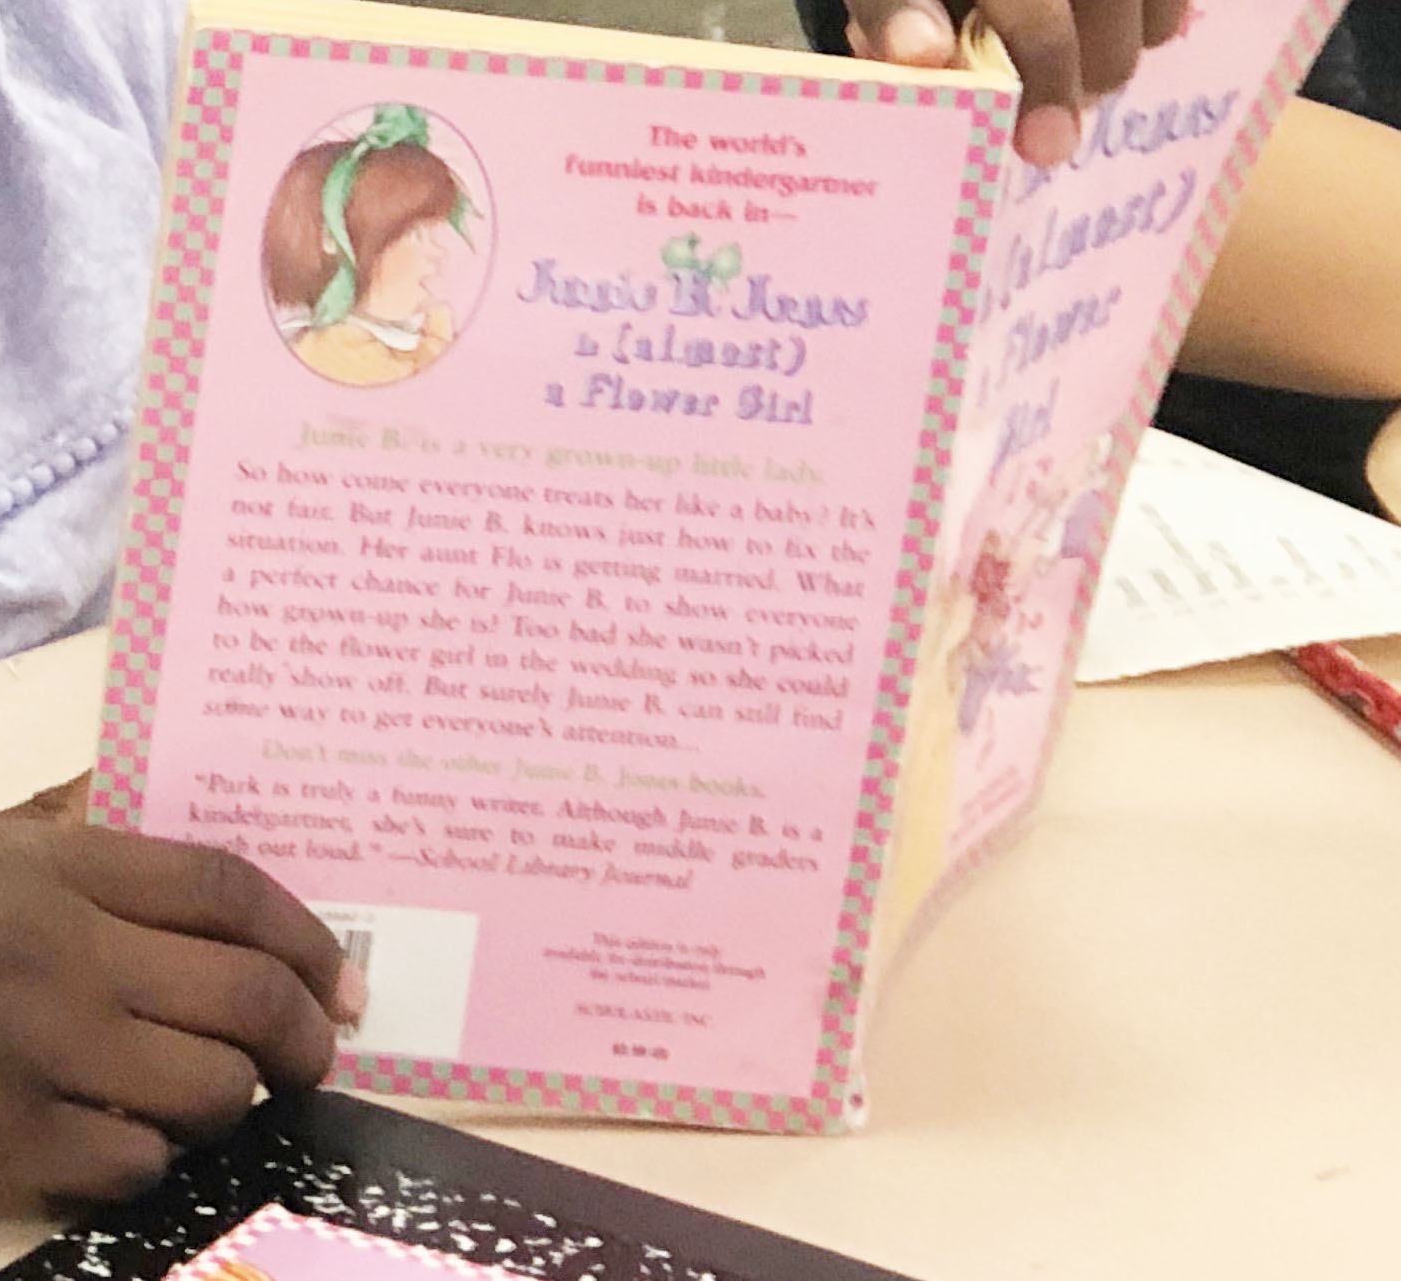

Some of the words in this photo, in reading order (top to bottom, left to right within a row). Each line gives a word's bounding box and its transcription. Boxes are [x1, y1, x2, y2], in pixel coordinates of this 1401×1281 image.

[649, 124, 697, 150] The
[709, 134, 806, 158] world's
[564, 153, 679, 184] funniest
[689, 164, 879, 197] kindergartner
[636, 193, 655, 215] is
[668, 195, 732, 220] back
[515, 258, 658, 313] Junie
[732, 274, 868, 329] Jones
[612, 320, 806, 377] (almost)
[545, 383, 565, 408] a
[579, 372, 719, 416] Flower
[737, 384, 813, 425] Girl
[297, 421, 369, 450] Junie
[478, 440, 532, 462] very
[546, 447, 681, 477] grown-up
[692, 452, 749, 479] little
[237, 461, 267, 482] So
[276, 461, 329, 486] how
[342, 475, 410, 494] come
[419, 477, 535, 504] everyone
[544, 487, 614, 509] treats
[624, 489, 664, 513] her
[675, 492, 721, 518] like
[730, 503, 743, 520] a
[840, 504, 876, 531] It's
[231, 499, 274, 518] not
[349, 501, 393, 526] But
[406, 504, 472, 531] Junie
[523, 514, 606, 541] knows
[618, 525, 666, 549] just
[677, 527, 730, 552] how
[747, 535, 773, 556] to
[785, 537, 817, 561] fix
[830, 539, 872, 565] the
[226, 533, 346, 557] situation.
[360, 534, 409, 560] Her
[420, 544, 479, 566] aunt
[491, 545, 534, 570] Flo
[543, 556, 562, 571] is
[572, 558, 661, 585] getting
[674, 565, 781, 593] married.
[796, 568, 866, 598] What
[216, 593, 270, 618] how
[283, 603, 409, 633] grown-up
[420, 608, 461, 633] she
[511, 614, 561, 640] Too
[569, 620, 618, 647] bad
[626, 624, 668, 651] she
[677, 634, 761, 659] wasn't
[769, 639, 855, 666] picked
[222, 567, 236, 583] a
[249, 567, 339, 591] perfect
[350, 568, 441, 596] chance
[453, 578, 493, 601] for
[503, 580, 572, 609] Junie
[625, 595, 650, 613] to
[664, 593, 729, 620] show
[744, 607, 861, 633] everyone
[212, 632, 240, 651] to
[249, 628, 279, 653] be
[288, 633, 329, 657] the
[339, 635, 422, 663] flower
[429, 643, 476, 669] girl
[484, 651, 509, 669] in
[519, 648, 560, 674] the
[569, 656, 678, 690] wedding
[689, 669, 718, 687] so
[725, 667, 768, 693] she
[775, 674, 849, 700] could
[202, 699, 270, 720] some
[278, 702, 328, 724] way
[339, 707, 368, 724] to
[373, 710, 414, 732] get
[421, 714, 554, 740] everyone's
[207, 662, 276, 689] really
[290, 665, 356, 691] show
[424, 673, 469, 700] But
[479, 682, 553, 710] surely
[565, 686, 633, 714] Junie
[678, 703, 724, 721] can
[734, 702, 782, 726] still
[792, 705, 845, 732] find
[260, 738, 328, 763] Don't
[337, 746, 388, 766] miss
[396, 745, 432, 771] the
[442, 752, 501, 775] other
[510, 757, 573, 784] Junie
[616, 766, 681, 791] Jones
[272, 779, 290, 797] is
[301, 779, 356, 804] truly
[367, 787, 381, 804] a
[391, 786, 457, 811] funny
[471, 796, 545, 817] writer.
[556, 798, 668, 831] Although
[677, 808, 739, 836] Junie
[782, 823, 801, 840] is
[810, 827, 824, 843] a
[257, 841, 298, 860] out
[506, 854, 594, 882] Library
[599, 861, 695, 891] Journal
[372, 813, 427, 836] she's
[443, 824, 494, 844] sure
[510, 828, 536, 847] to
[552, 830, 617, 855] make
[632, 836, 716, 864] middle
[731, 847, 820, 872] graders
